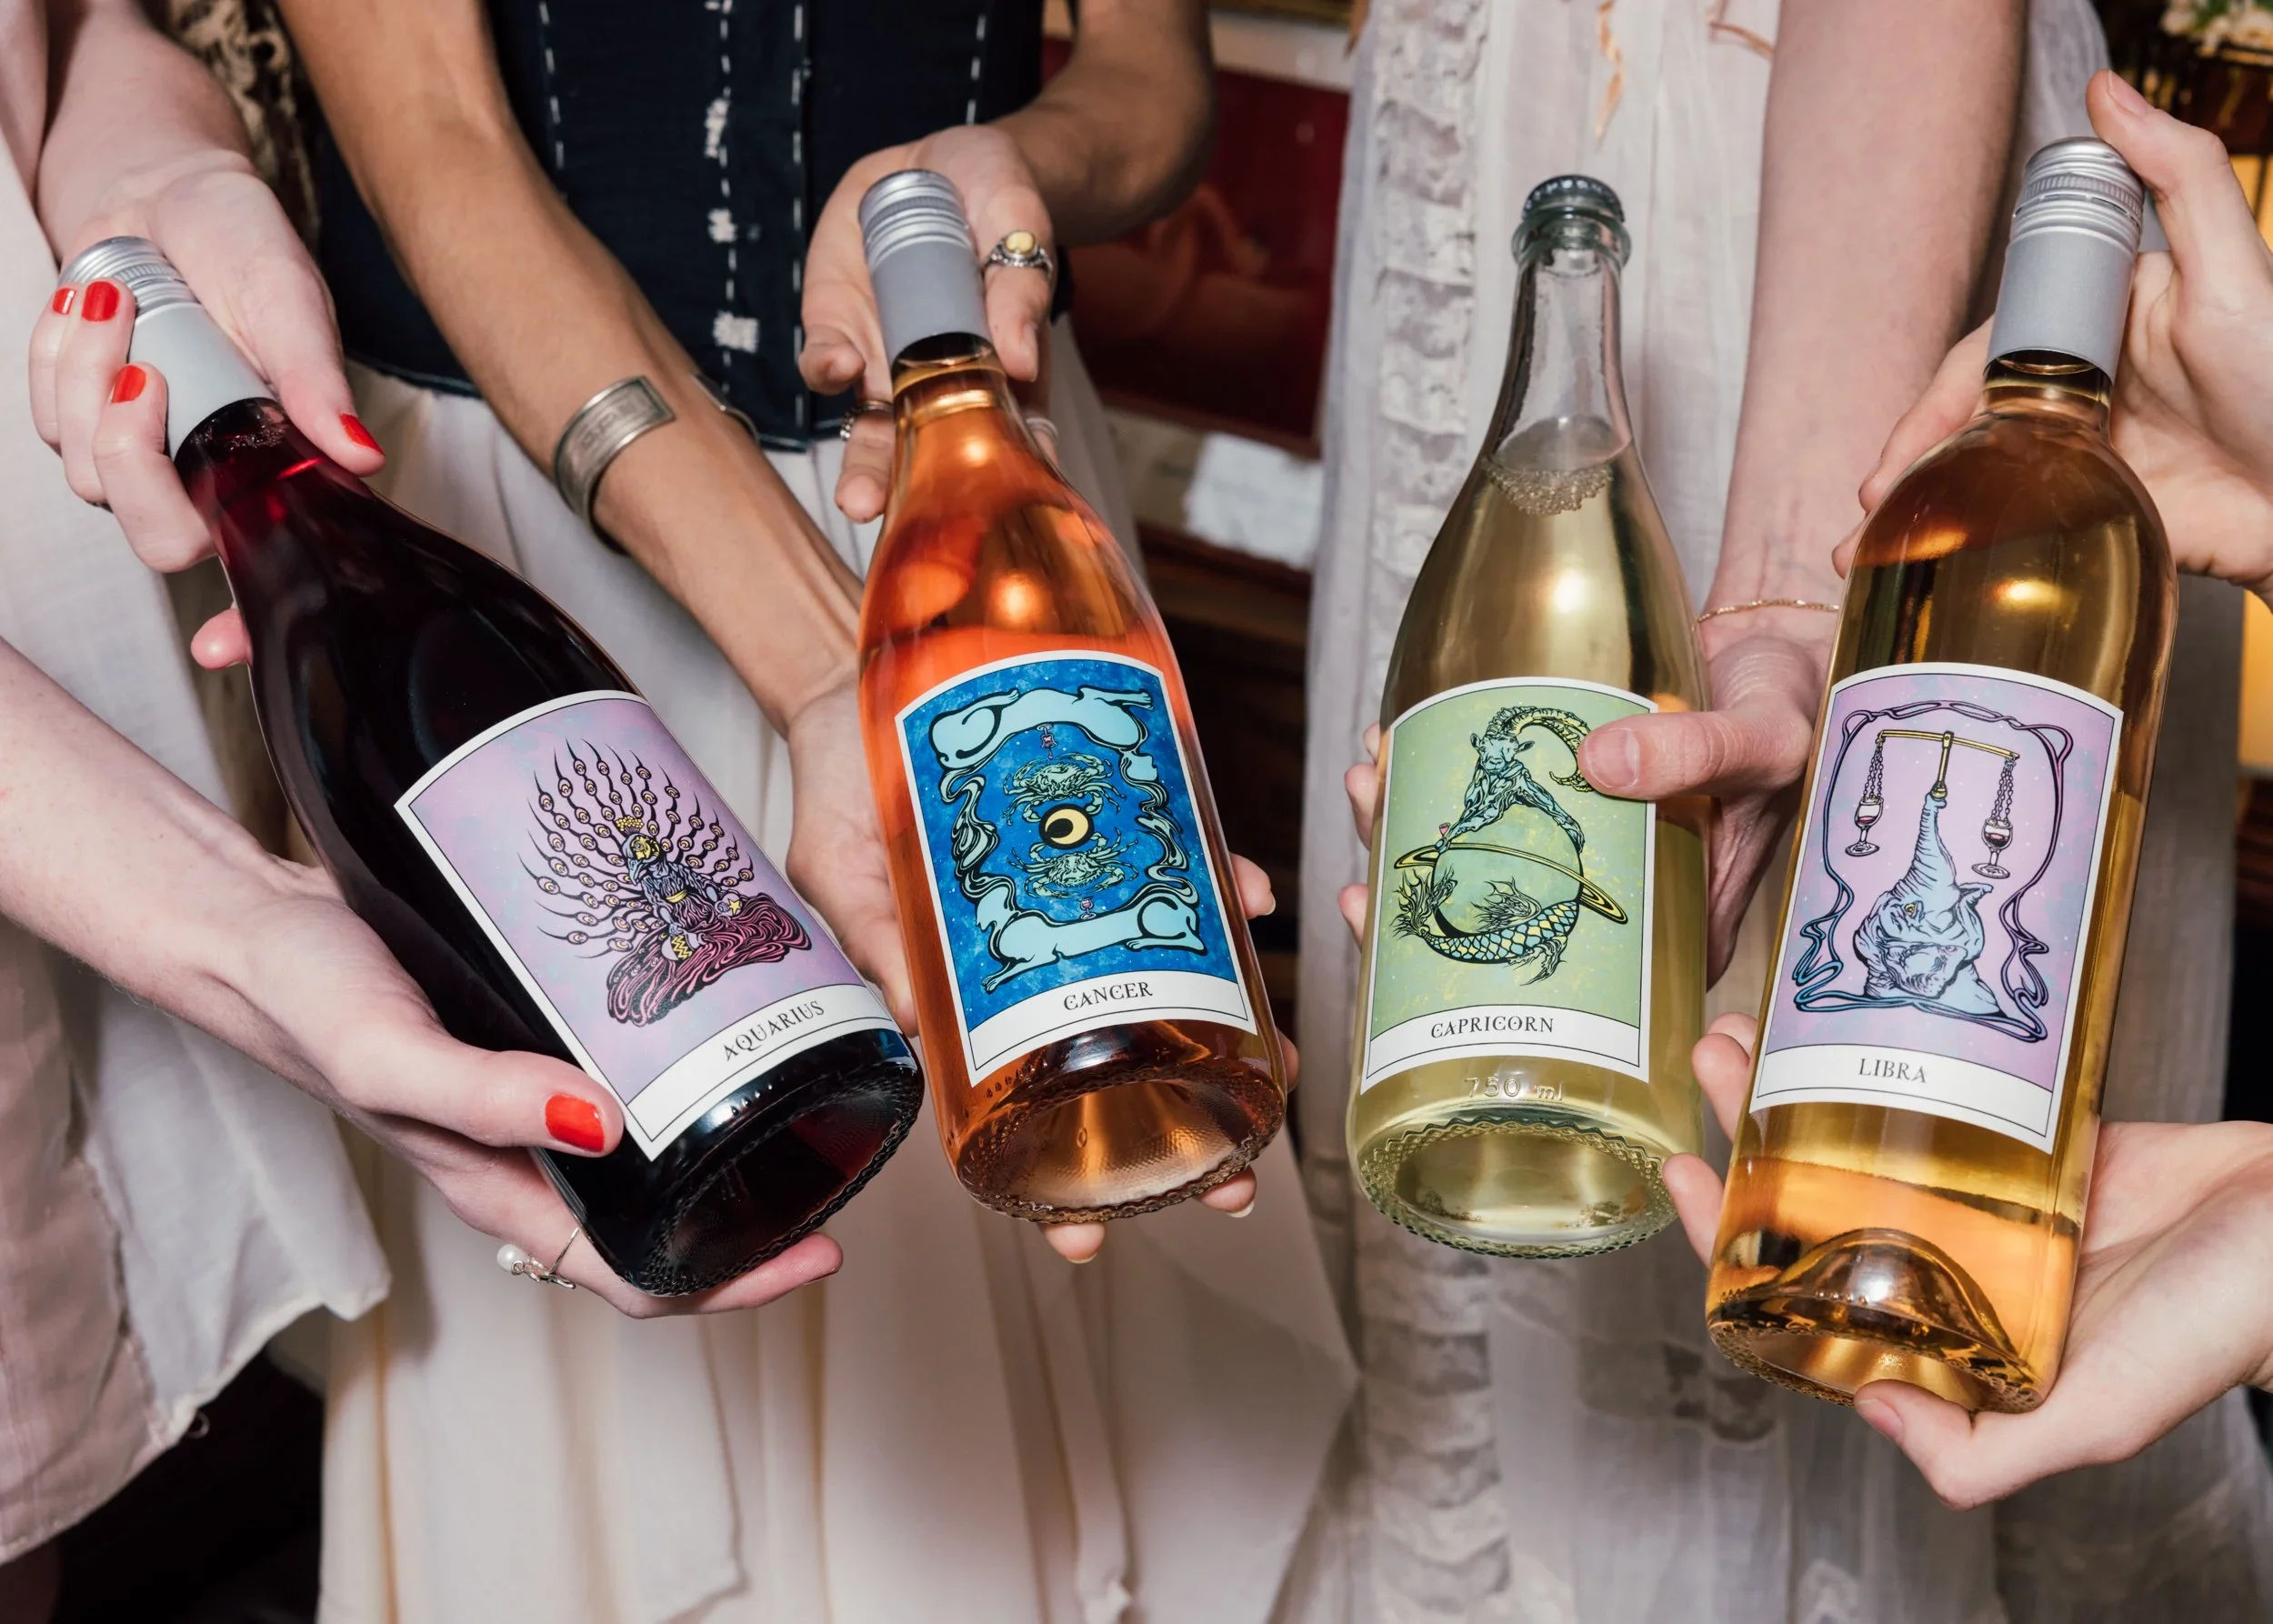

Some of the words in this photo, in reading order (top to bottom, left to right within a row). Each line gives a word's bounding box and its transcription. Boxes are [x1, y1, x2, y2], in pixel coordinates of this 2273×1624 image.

[1064, 981, 1153, 1010] CANCER
[724, 1000, 825, 1061] AQUARIUS
[1431, 1016, 1554, 1038] CAPRICORN
[1859, 1058, 1927, 1083] LIBRA
[1464, 1076, 1520, 1098] 750
[1534, 1081, 1564, 1100] ml
